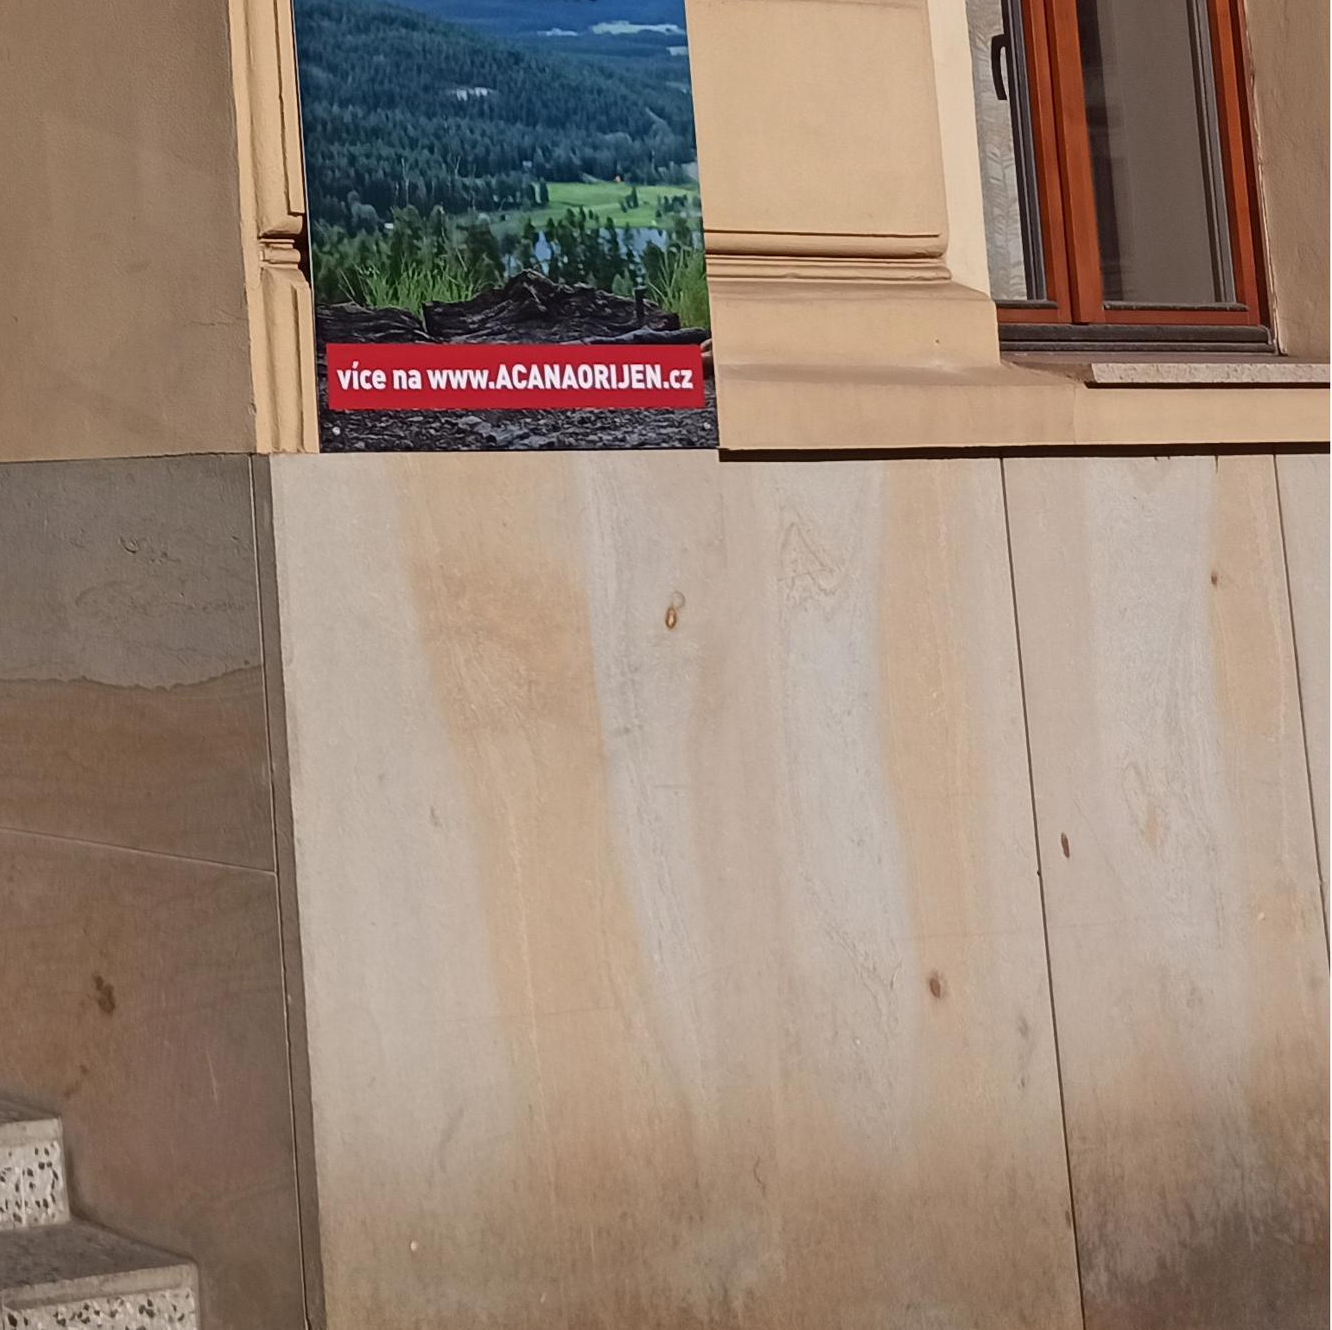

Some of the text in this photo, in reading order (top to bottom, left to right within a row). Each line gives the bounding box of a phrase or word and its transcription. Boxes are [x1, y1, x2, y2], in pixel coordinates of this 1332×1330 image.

[336, 361, 693, 391] více na www.ACANAORIJEN.cz
